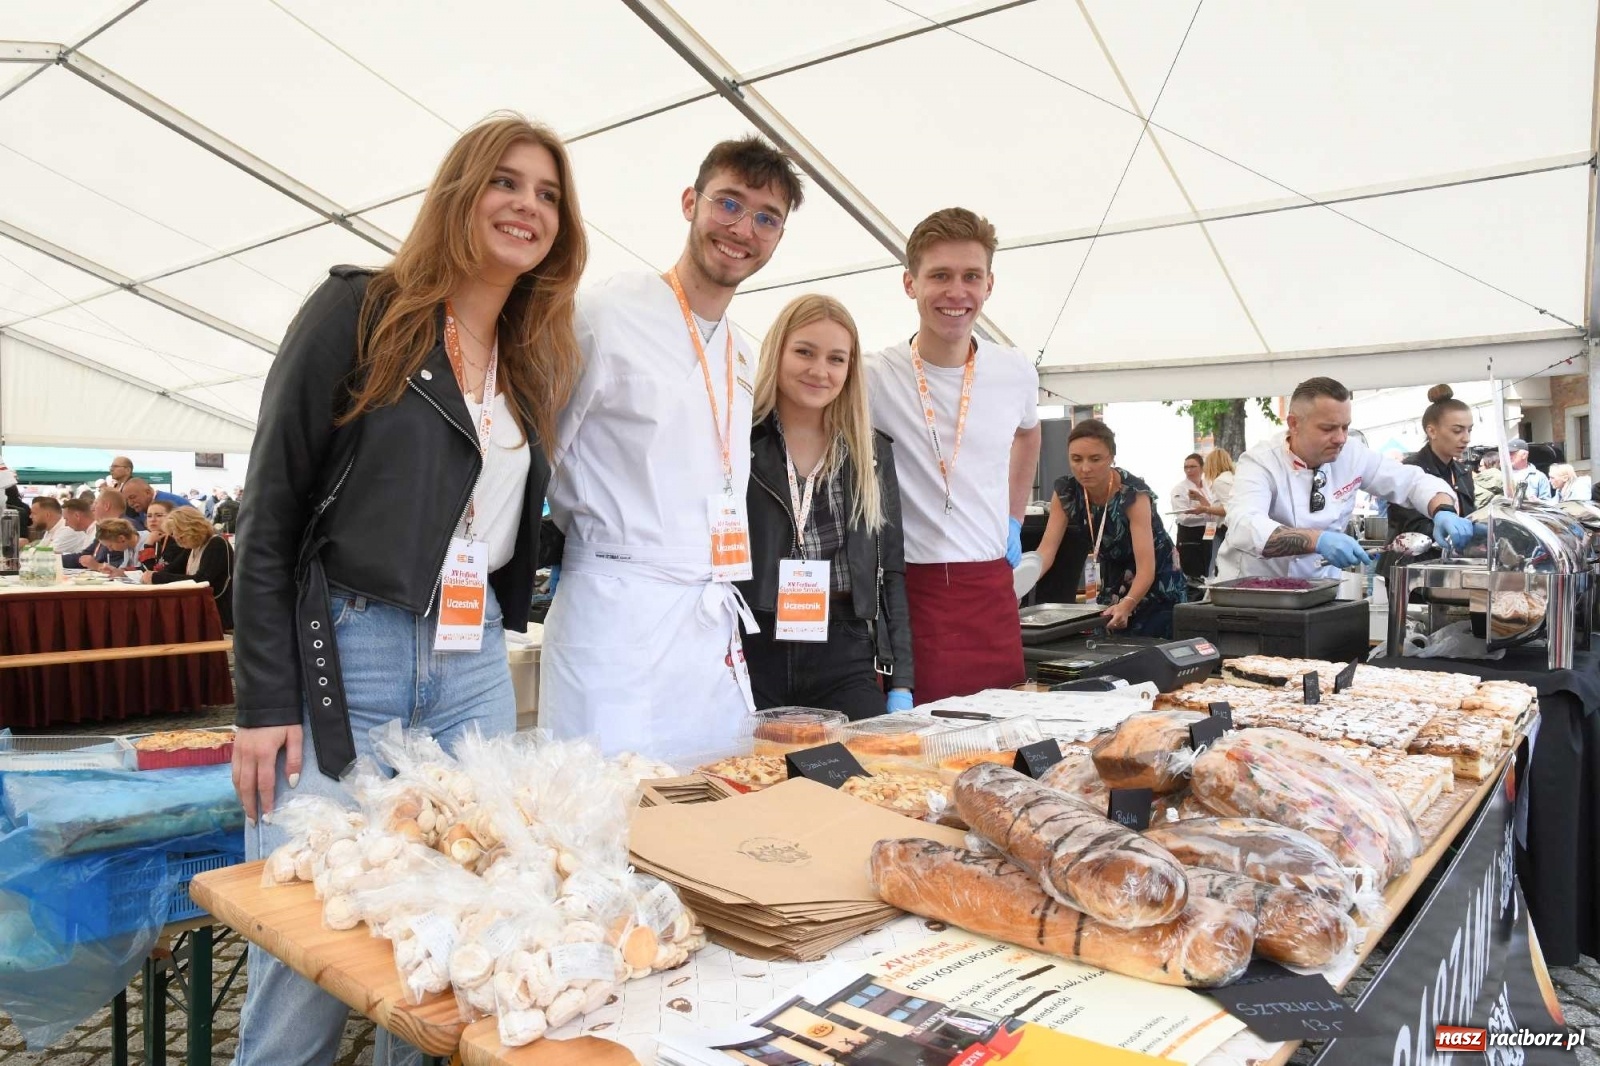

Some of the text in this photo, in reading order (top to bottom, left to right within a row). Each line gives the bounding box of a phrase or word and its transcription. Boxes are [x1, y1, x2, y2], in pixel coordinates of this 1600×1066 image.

[446, 598, 480, 610] Uczestnik
[783, 601, 822, 611] Uczestnik
[905, 973, 936, 991] ENU
[933, 943, 1010, 979] KONKURSOWE
[1236, 1000, 1343, 1017] SZTRUCLA
